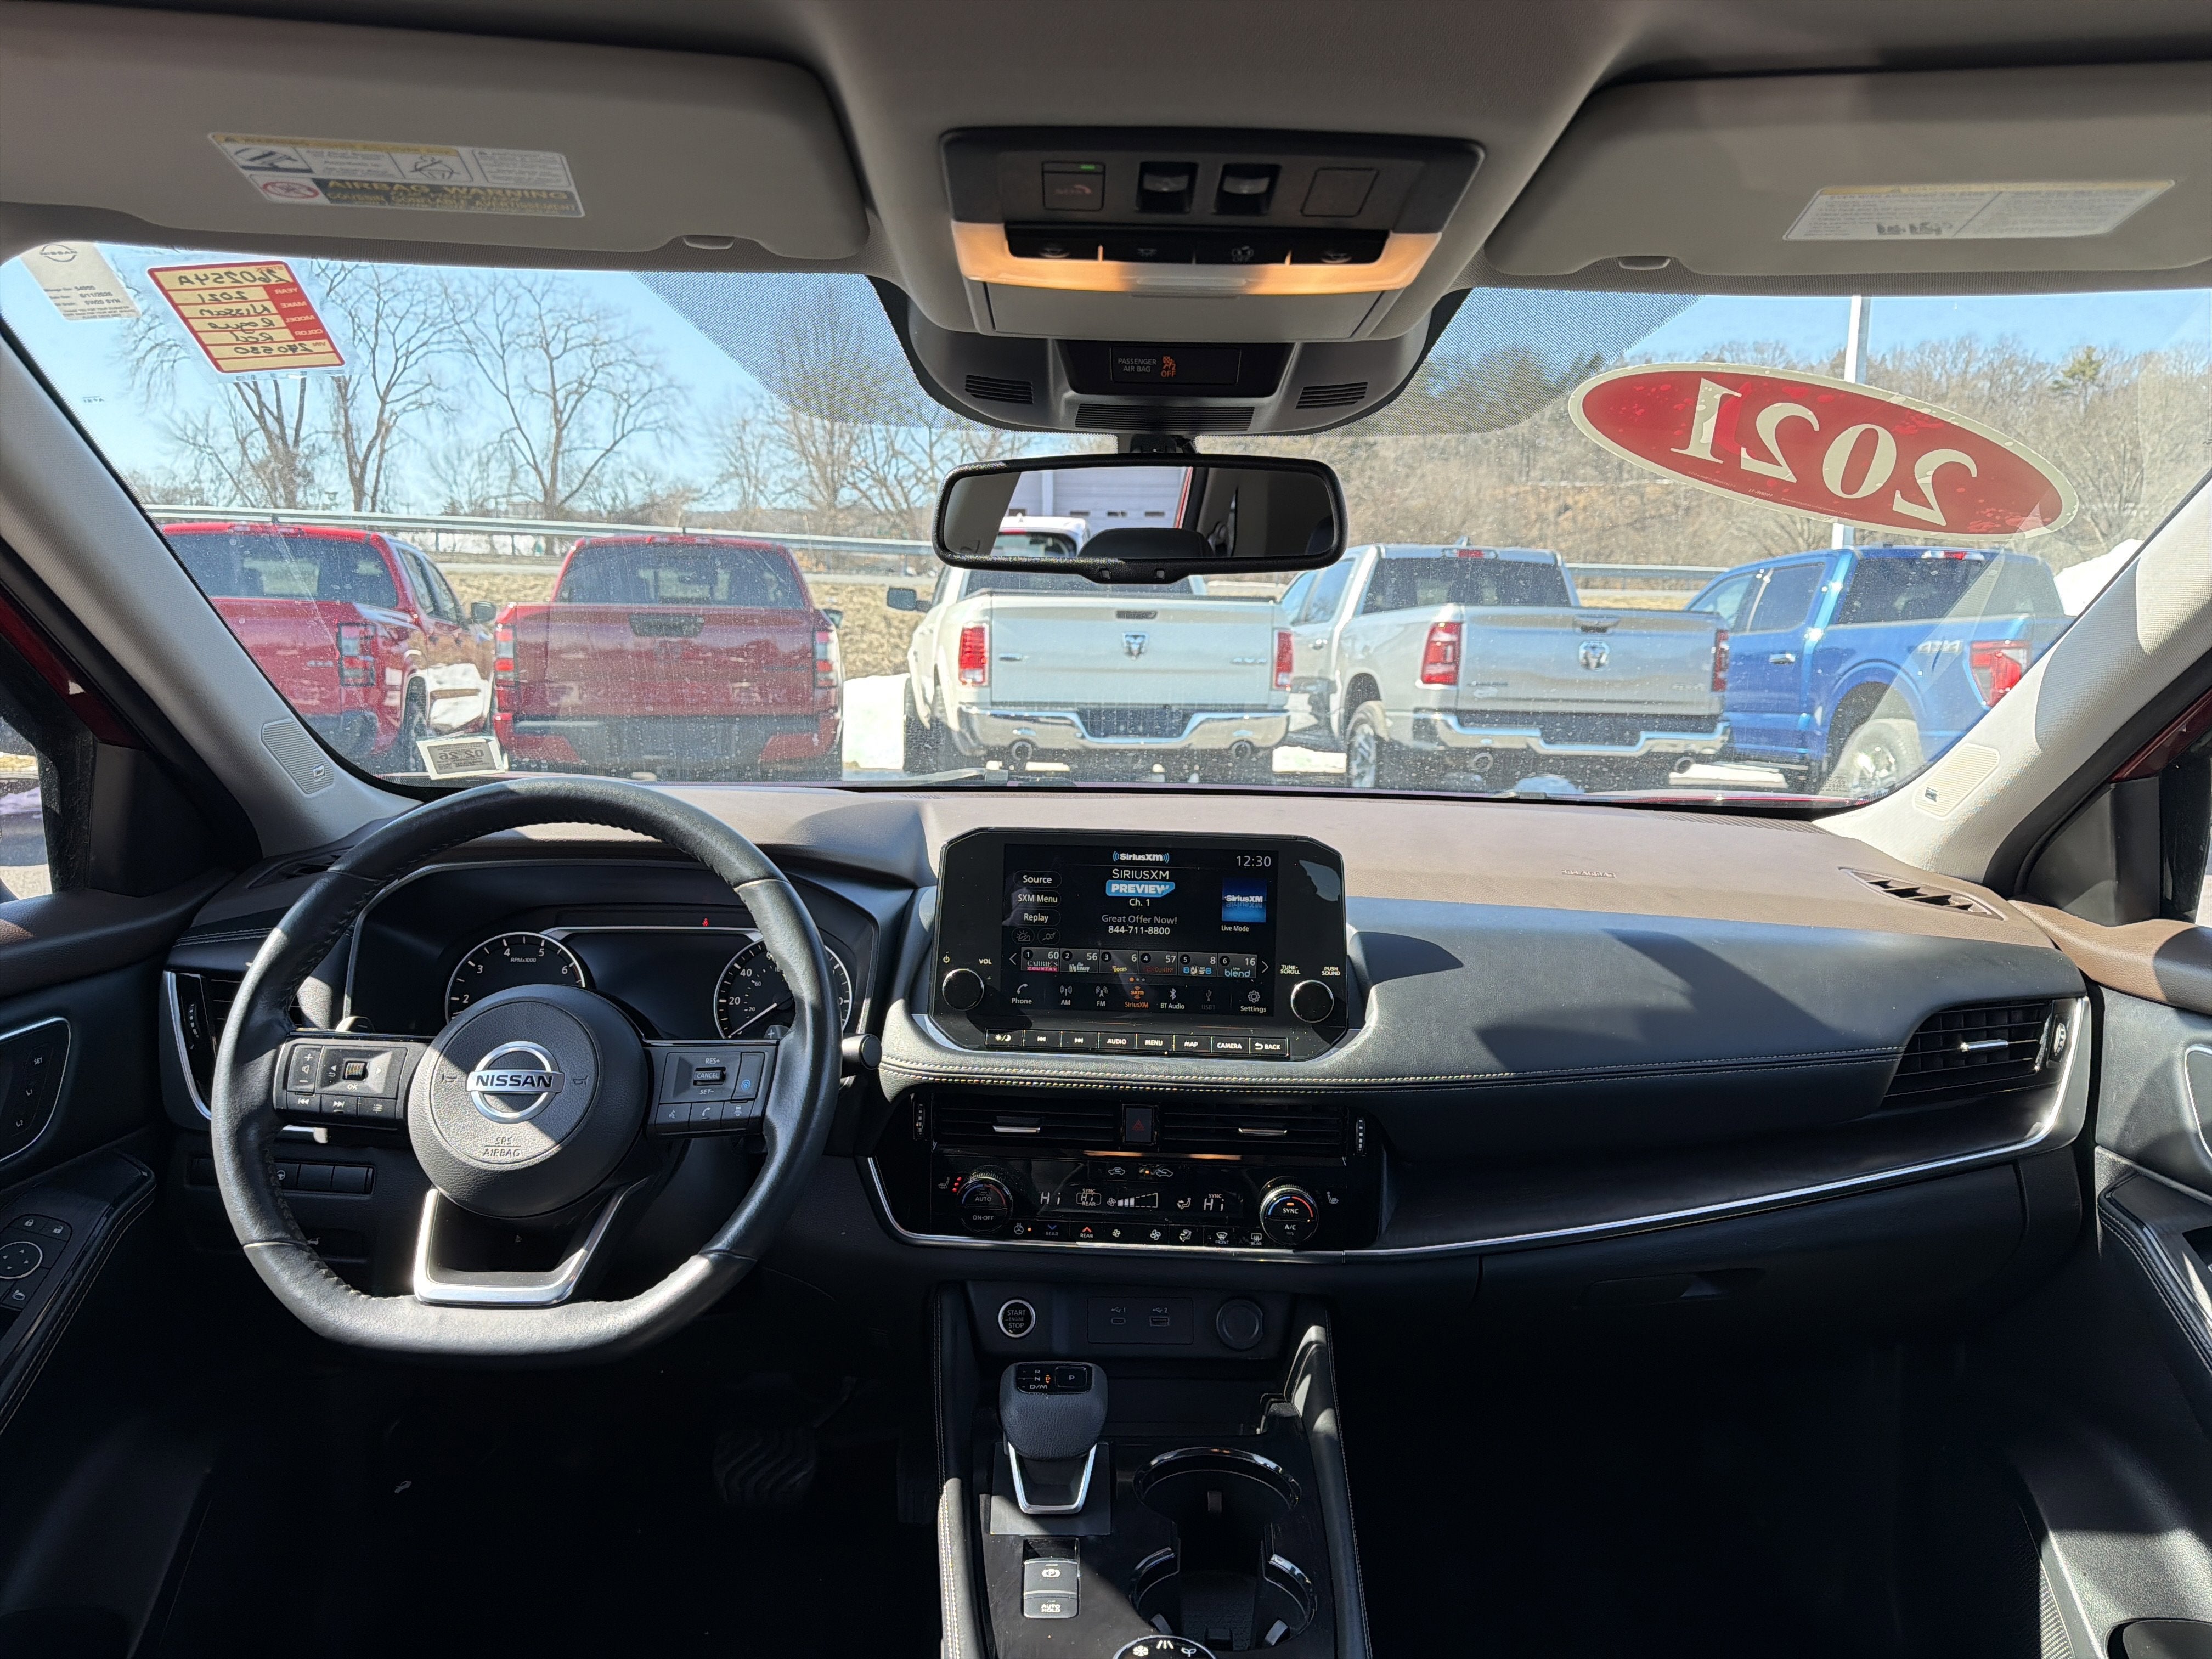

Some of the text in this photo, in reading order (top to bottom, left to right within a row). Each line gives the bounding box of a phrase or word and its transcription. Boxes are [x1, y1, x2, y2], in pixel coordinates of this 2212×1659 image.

[1236, 856, 1271, 867] 12:30
[1112, 868, 1169, 880] SIRIUSXM
[1023, 875, 1052, 884] Source
[1111, 884, 1169, 894] PREVIEW
[1037, 895, 1058, 903] Menu
[1129, 898, 1143, 906] Ch.
[1024, 913, 1049, 923] Replay
[1102, 915, 1177, 924] Great Offer Now!
[1108, 926, 1170, 935] 844-711-8800
[504, 948, 510, 957] 4
[539, 948, 545, 957] 5
[1048, 951, 1059, 960] 60
[1165, 955, 1176, 963] 57
[1245, 957, 1255, 966] 16
[477, 965, 483, 973] 3
[561, 966, 568, 974] 6
[740, 968, 752, 977] 40
[462, 994, 469, 1003] 2
[729, 997, 740, 1005] 20
[476, 1075, 553, 1087] NISSAN
[495, 1137, 512, 1145] SRS
[483, 1148, 520, 1157] AIRBAG
[1040, 1192, 1061, 1205] Hi
[1203, 1198, 1224, 1211] Hi
